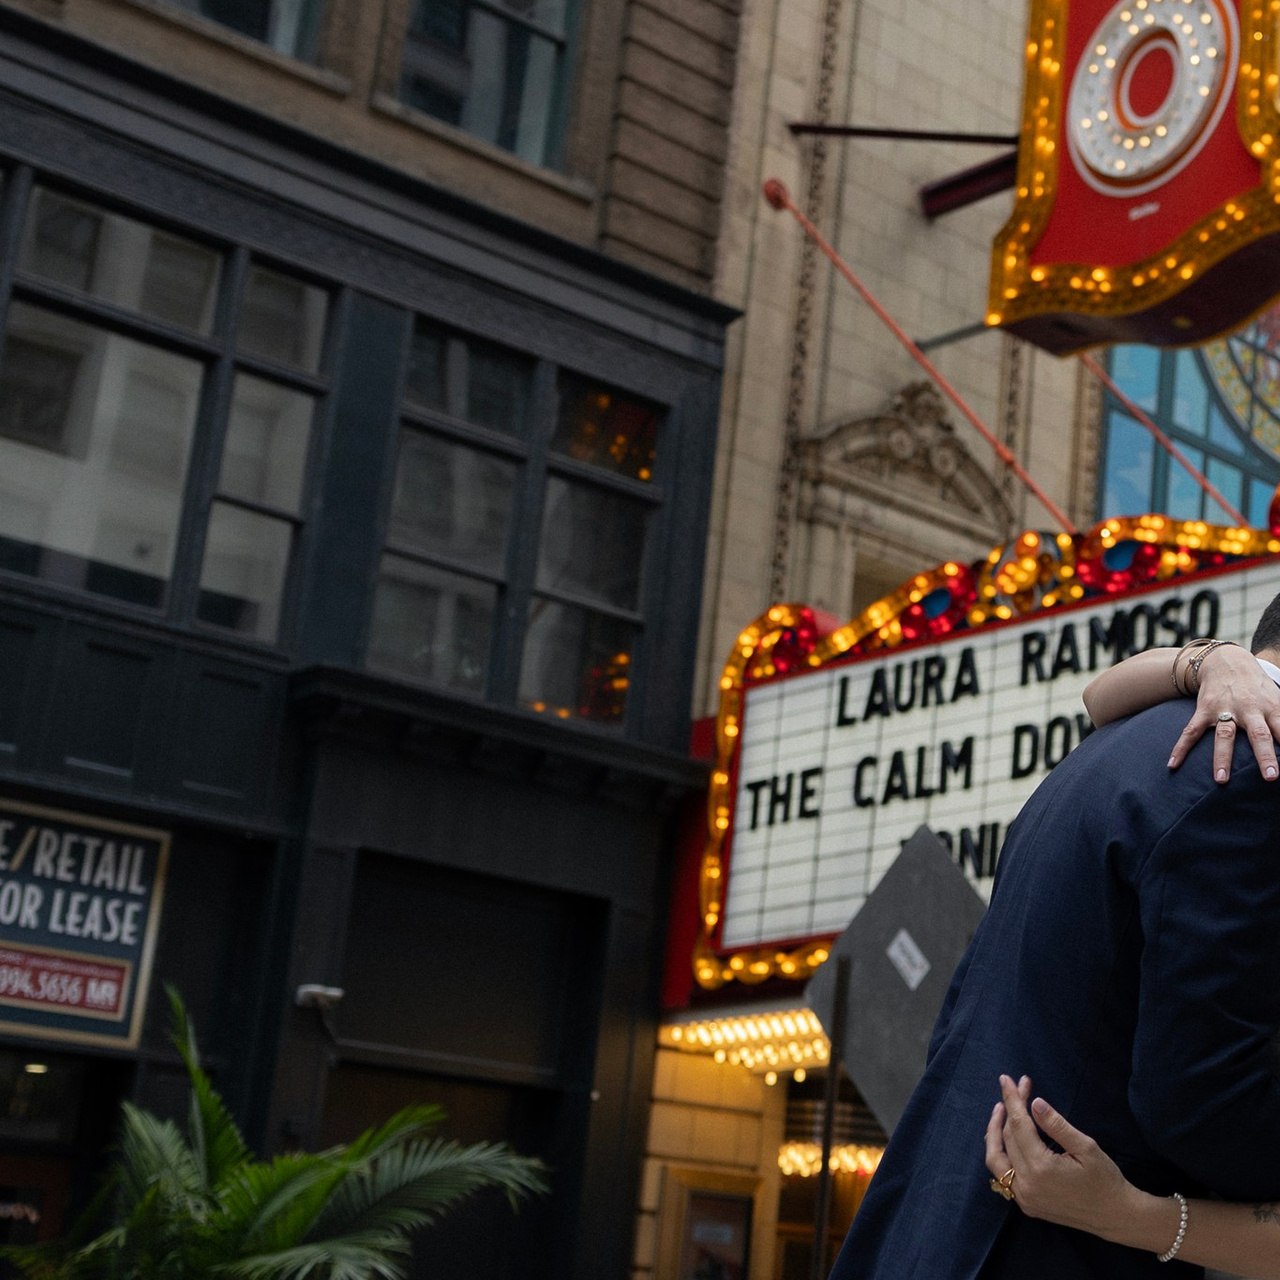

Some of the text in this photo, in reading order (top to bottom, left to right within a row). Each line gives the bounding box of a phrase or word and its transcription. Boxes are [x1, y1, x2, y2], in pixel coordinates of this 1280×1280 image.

[836, 588, 1220, 728] LAURA RAMOSO
[746, 767, 823, 831] THE
[853, 736, 974, 809] CALM
[0, 878, 144, 947] OR LEASE
